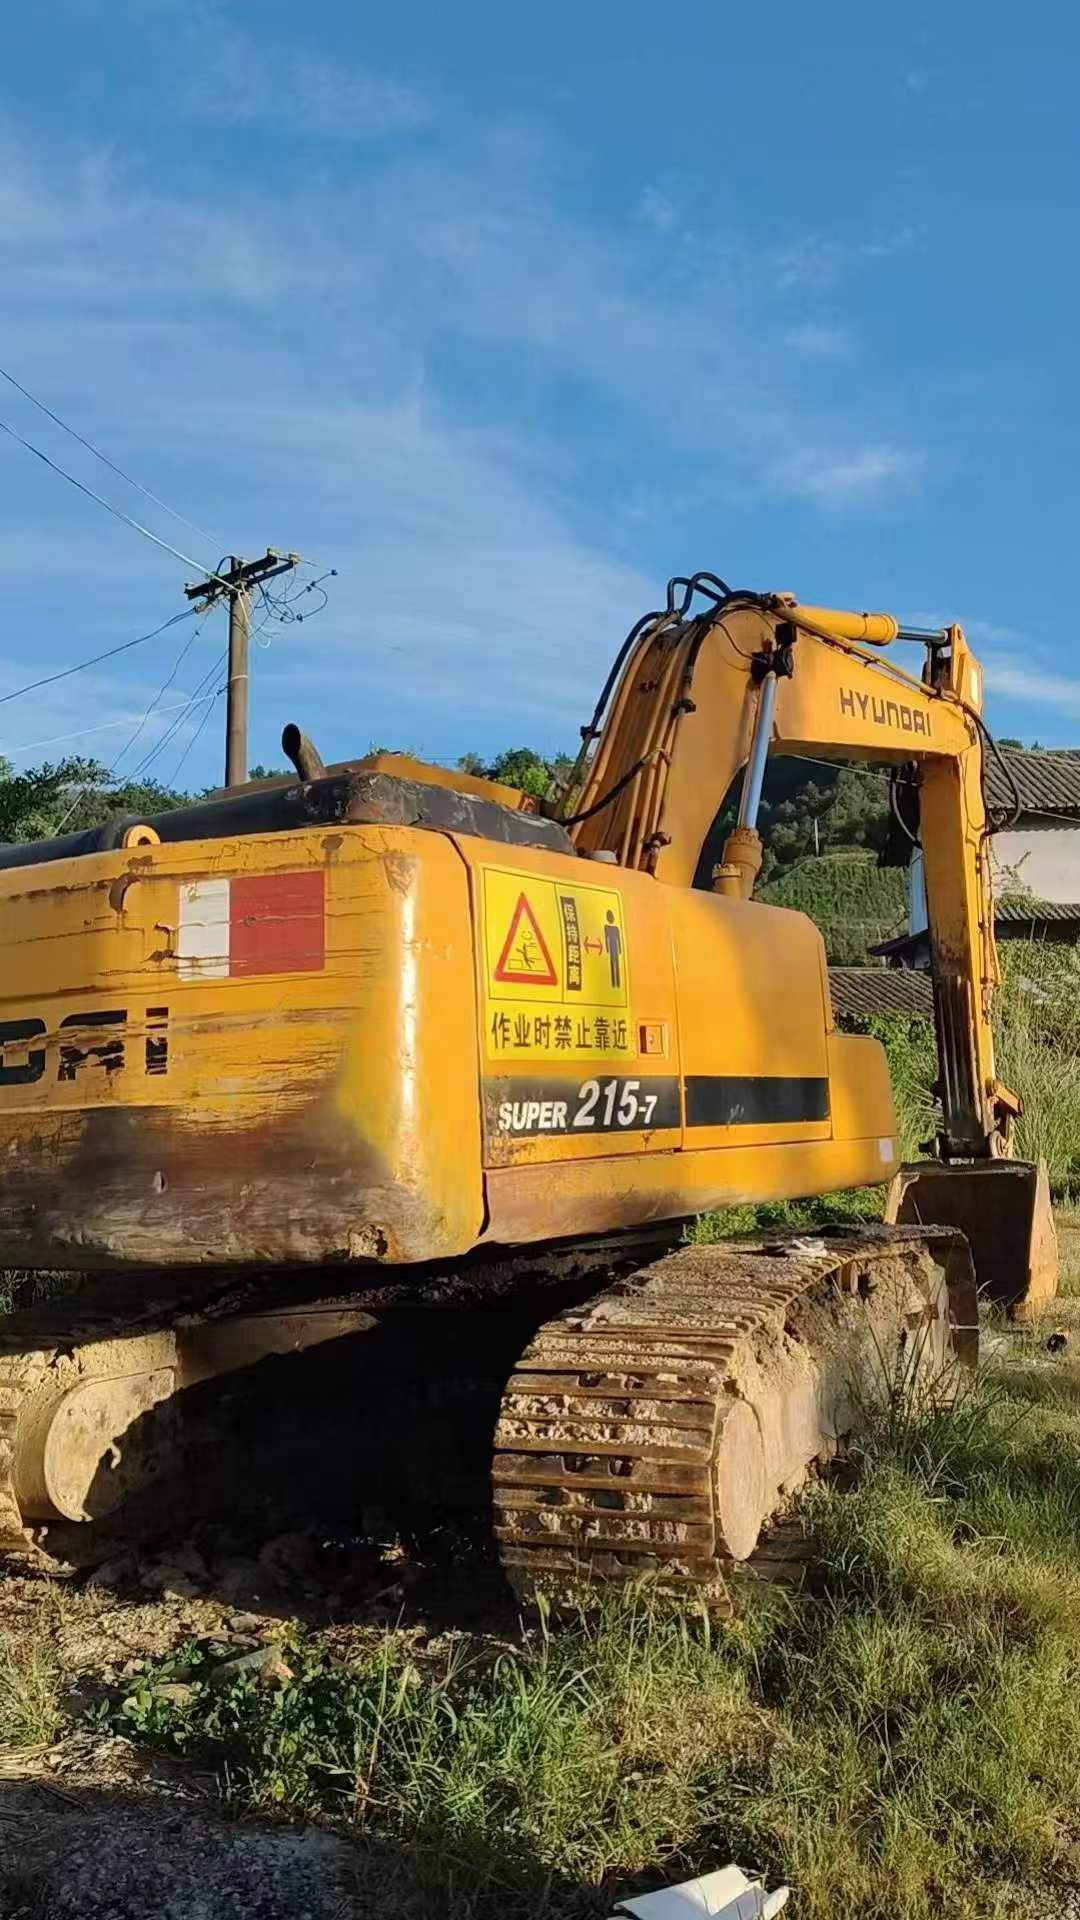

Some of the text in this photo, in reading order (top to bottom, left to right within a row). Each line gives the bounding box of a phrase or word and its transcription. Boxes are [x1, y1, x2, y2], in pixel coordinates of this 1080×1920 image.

[839, 687, 931, 737] HYUNDAI
[491, 1012, 628, 1050] 作业时禁止靠近
[498, 1101, 567, 1131] SUPER
